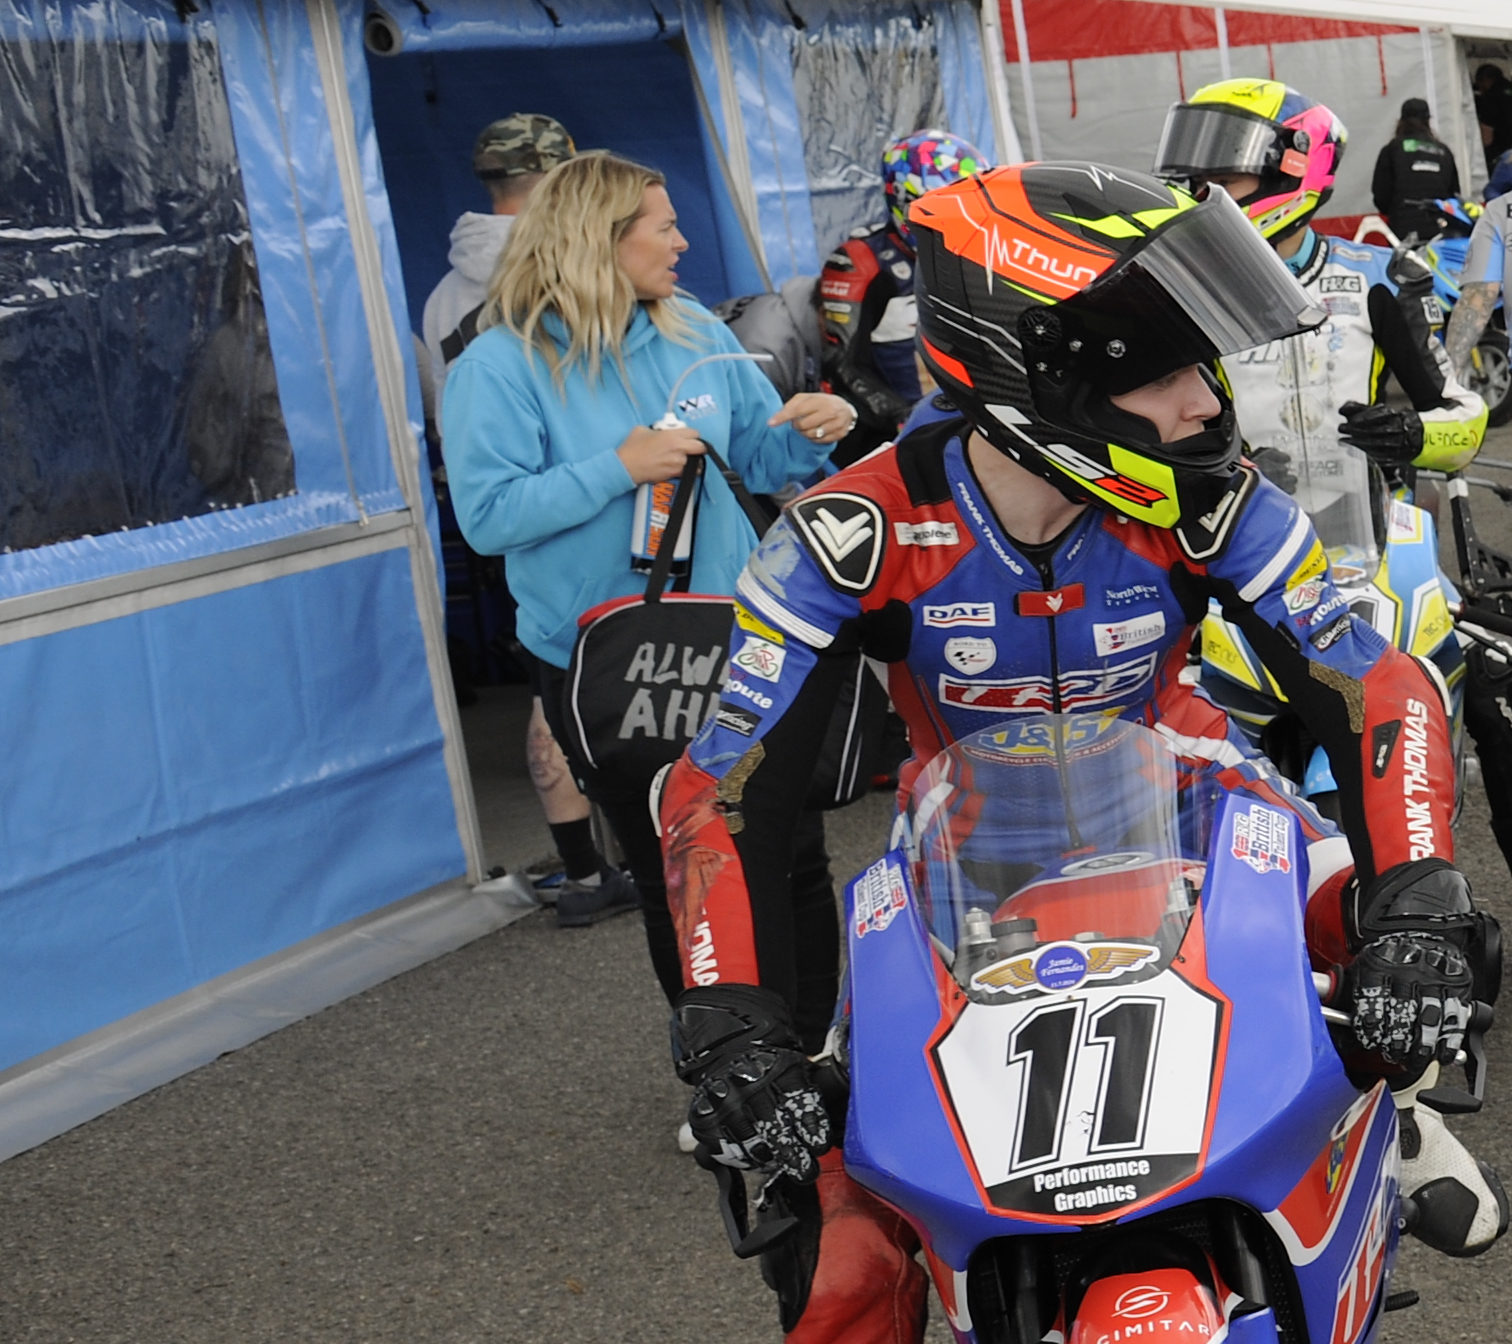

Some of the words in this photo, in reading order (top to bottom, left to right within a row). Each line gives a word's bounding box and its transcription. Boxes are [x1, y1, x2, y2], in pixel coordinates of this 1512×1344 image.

[1322, 277, 1360, 291] R&G
[956, 481, 983, 528] FRANK
[983, 525, 1025, 577] THOMAS
[928, 608, 992, 618] DAF
[1403, 698, 1430, 797] THOMAS
[1253, 809, 1270, 853] British
[1408, 800, 1435, 862] RANK
[869, 861, 887, 911] British
[1040, 963, 1085, 978] Fernandes
[1047, 956, 1074, 967] Jamie
[1006, 994, 1166, 1175] 11
[1033, 1160, 1151, 1193] Performance
[1054, 1185, 1138, 1212] Graphics
